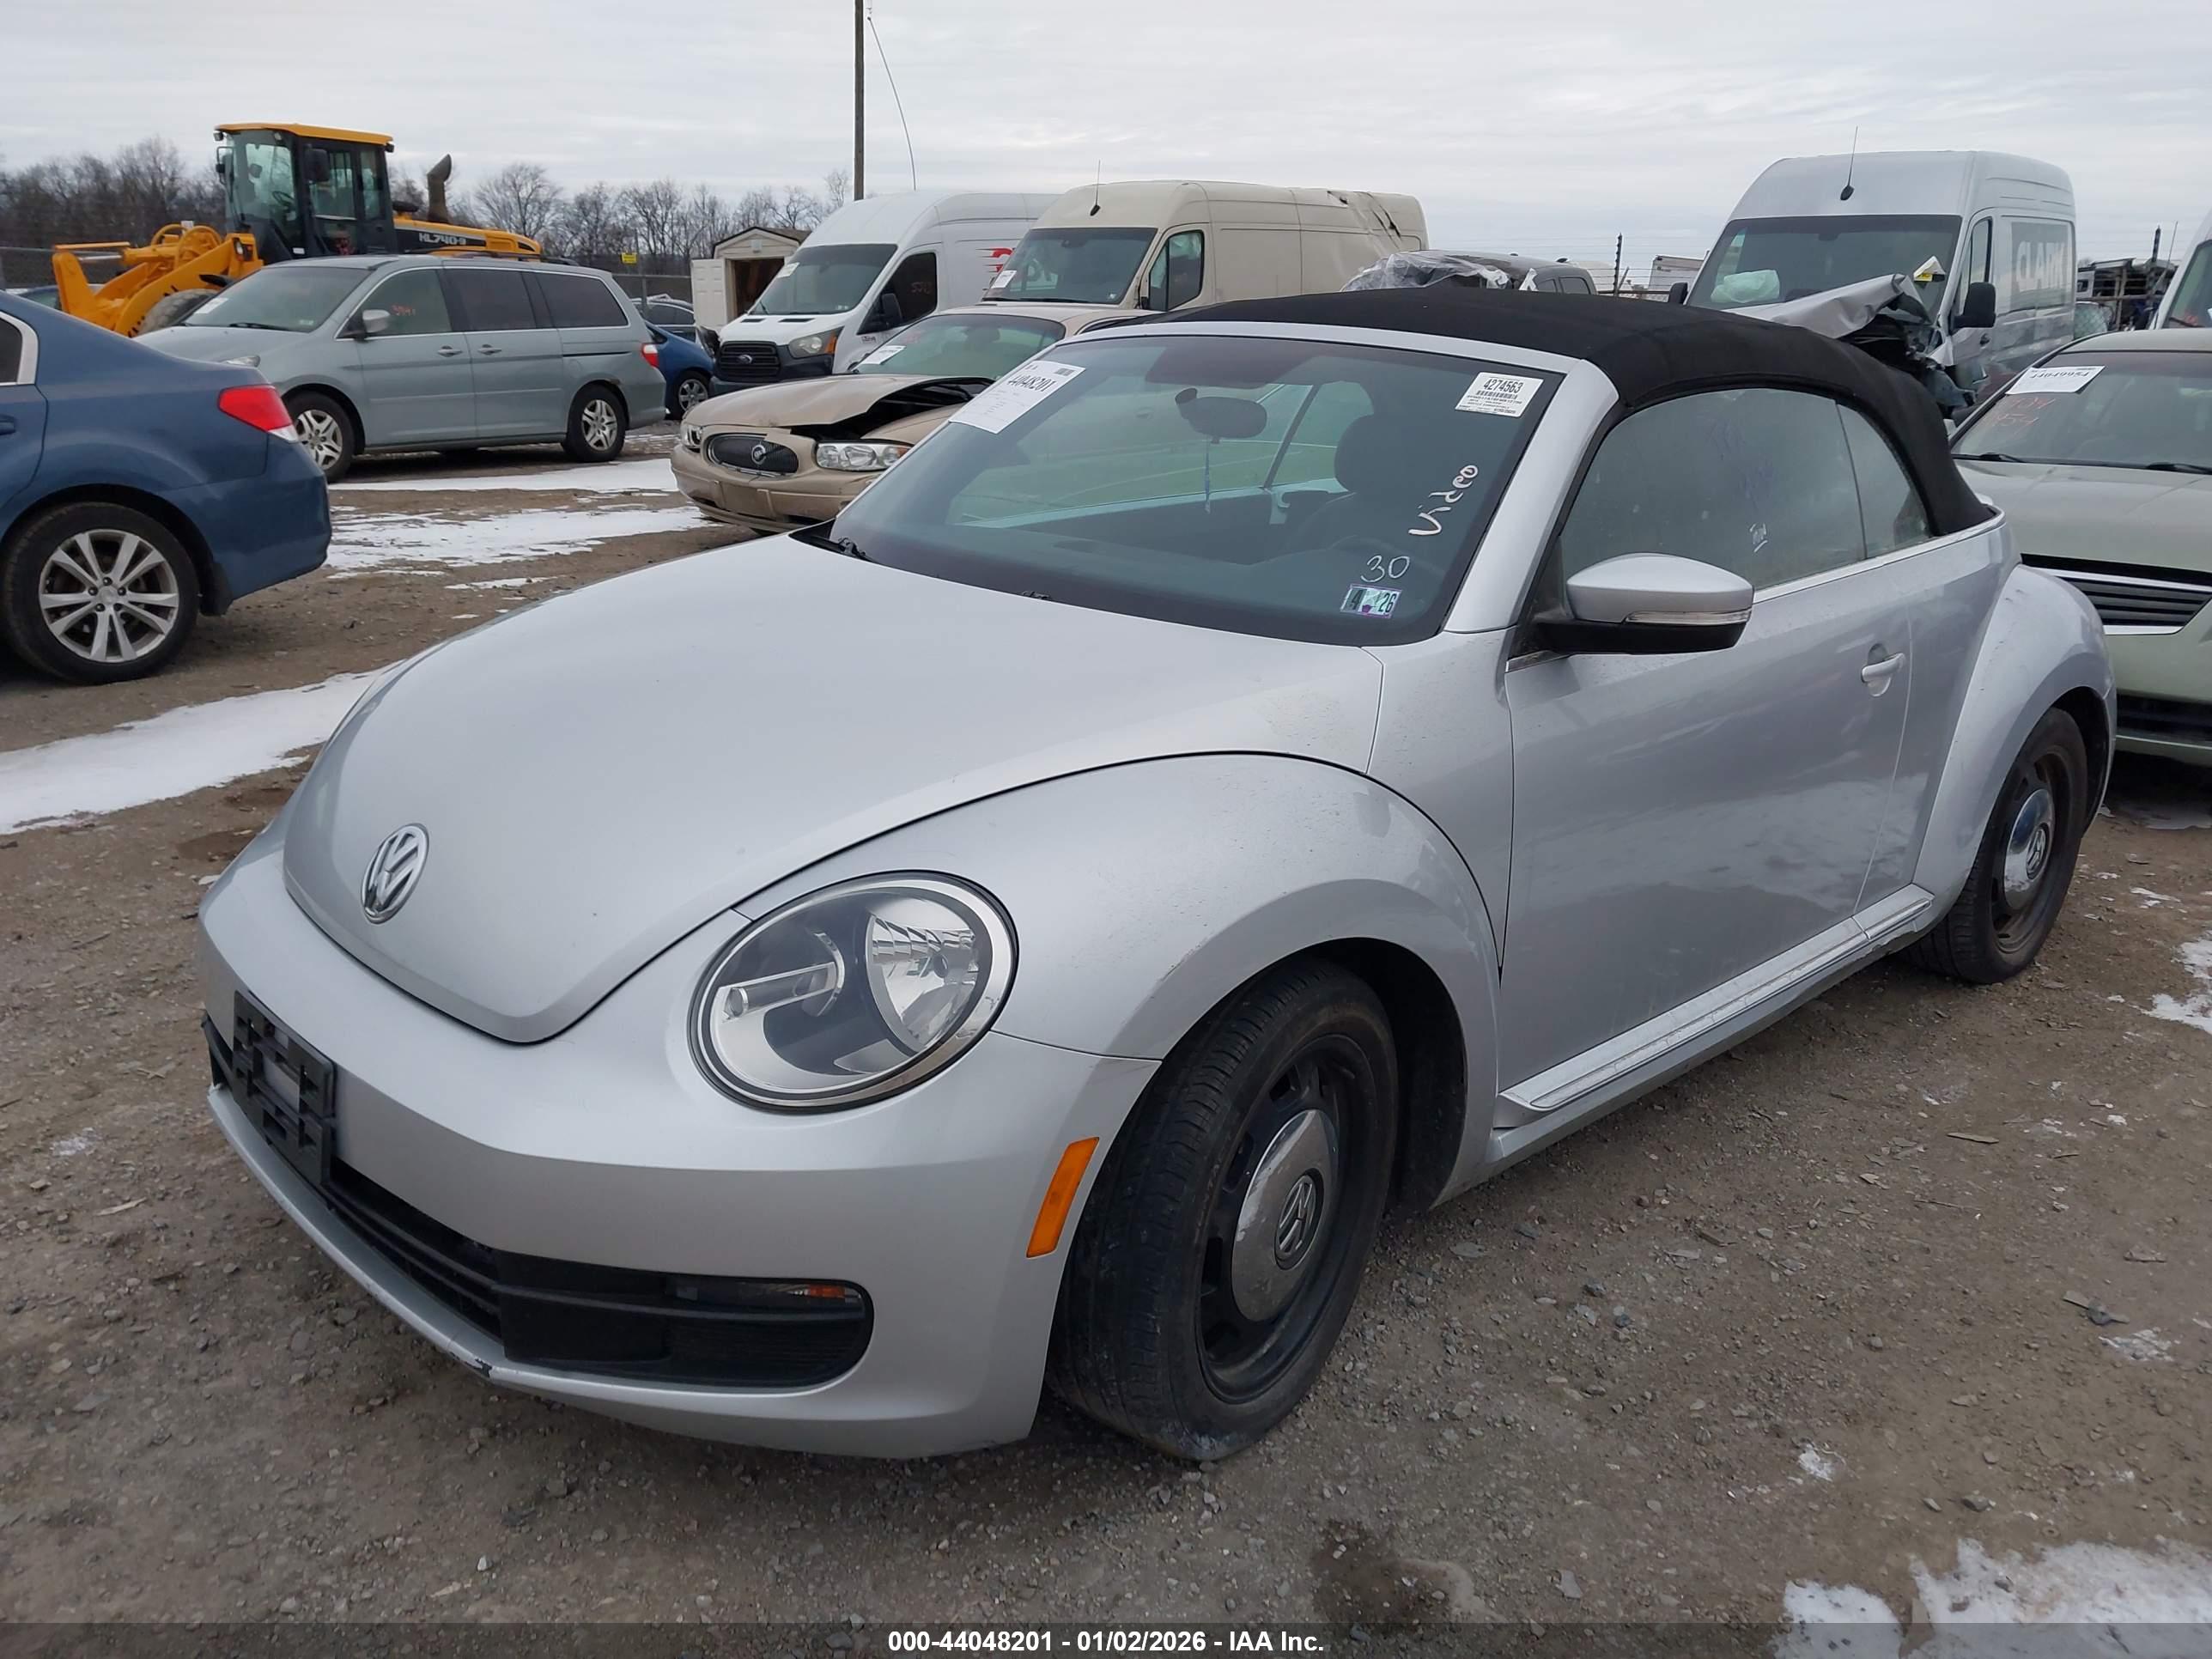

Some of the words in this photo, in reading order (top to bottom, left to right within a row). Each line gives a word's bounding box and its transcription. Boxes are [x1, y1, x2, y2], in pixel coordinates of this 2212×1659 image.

[1483, 378, 1524, 393] 4274563
[1407, 465, 1479, 536] Video
[1360, 555, 1410, 582] 30
[1377, 592, 1398, 613] 26
